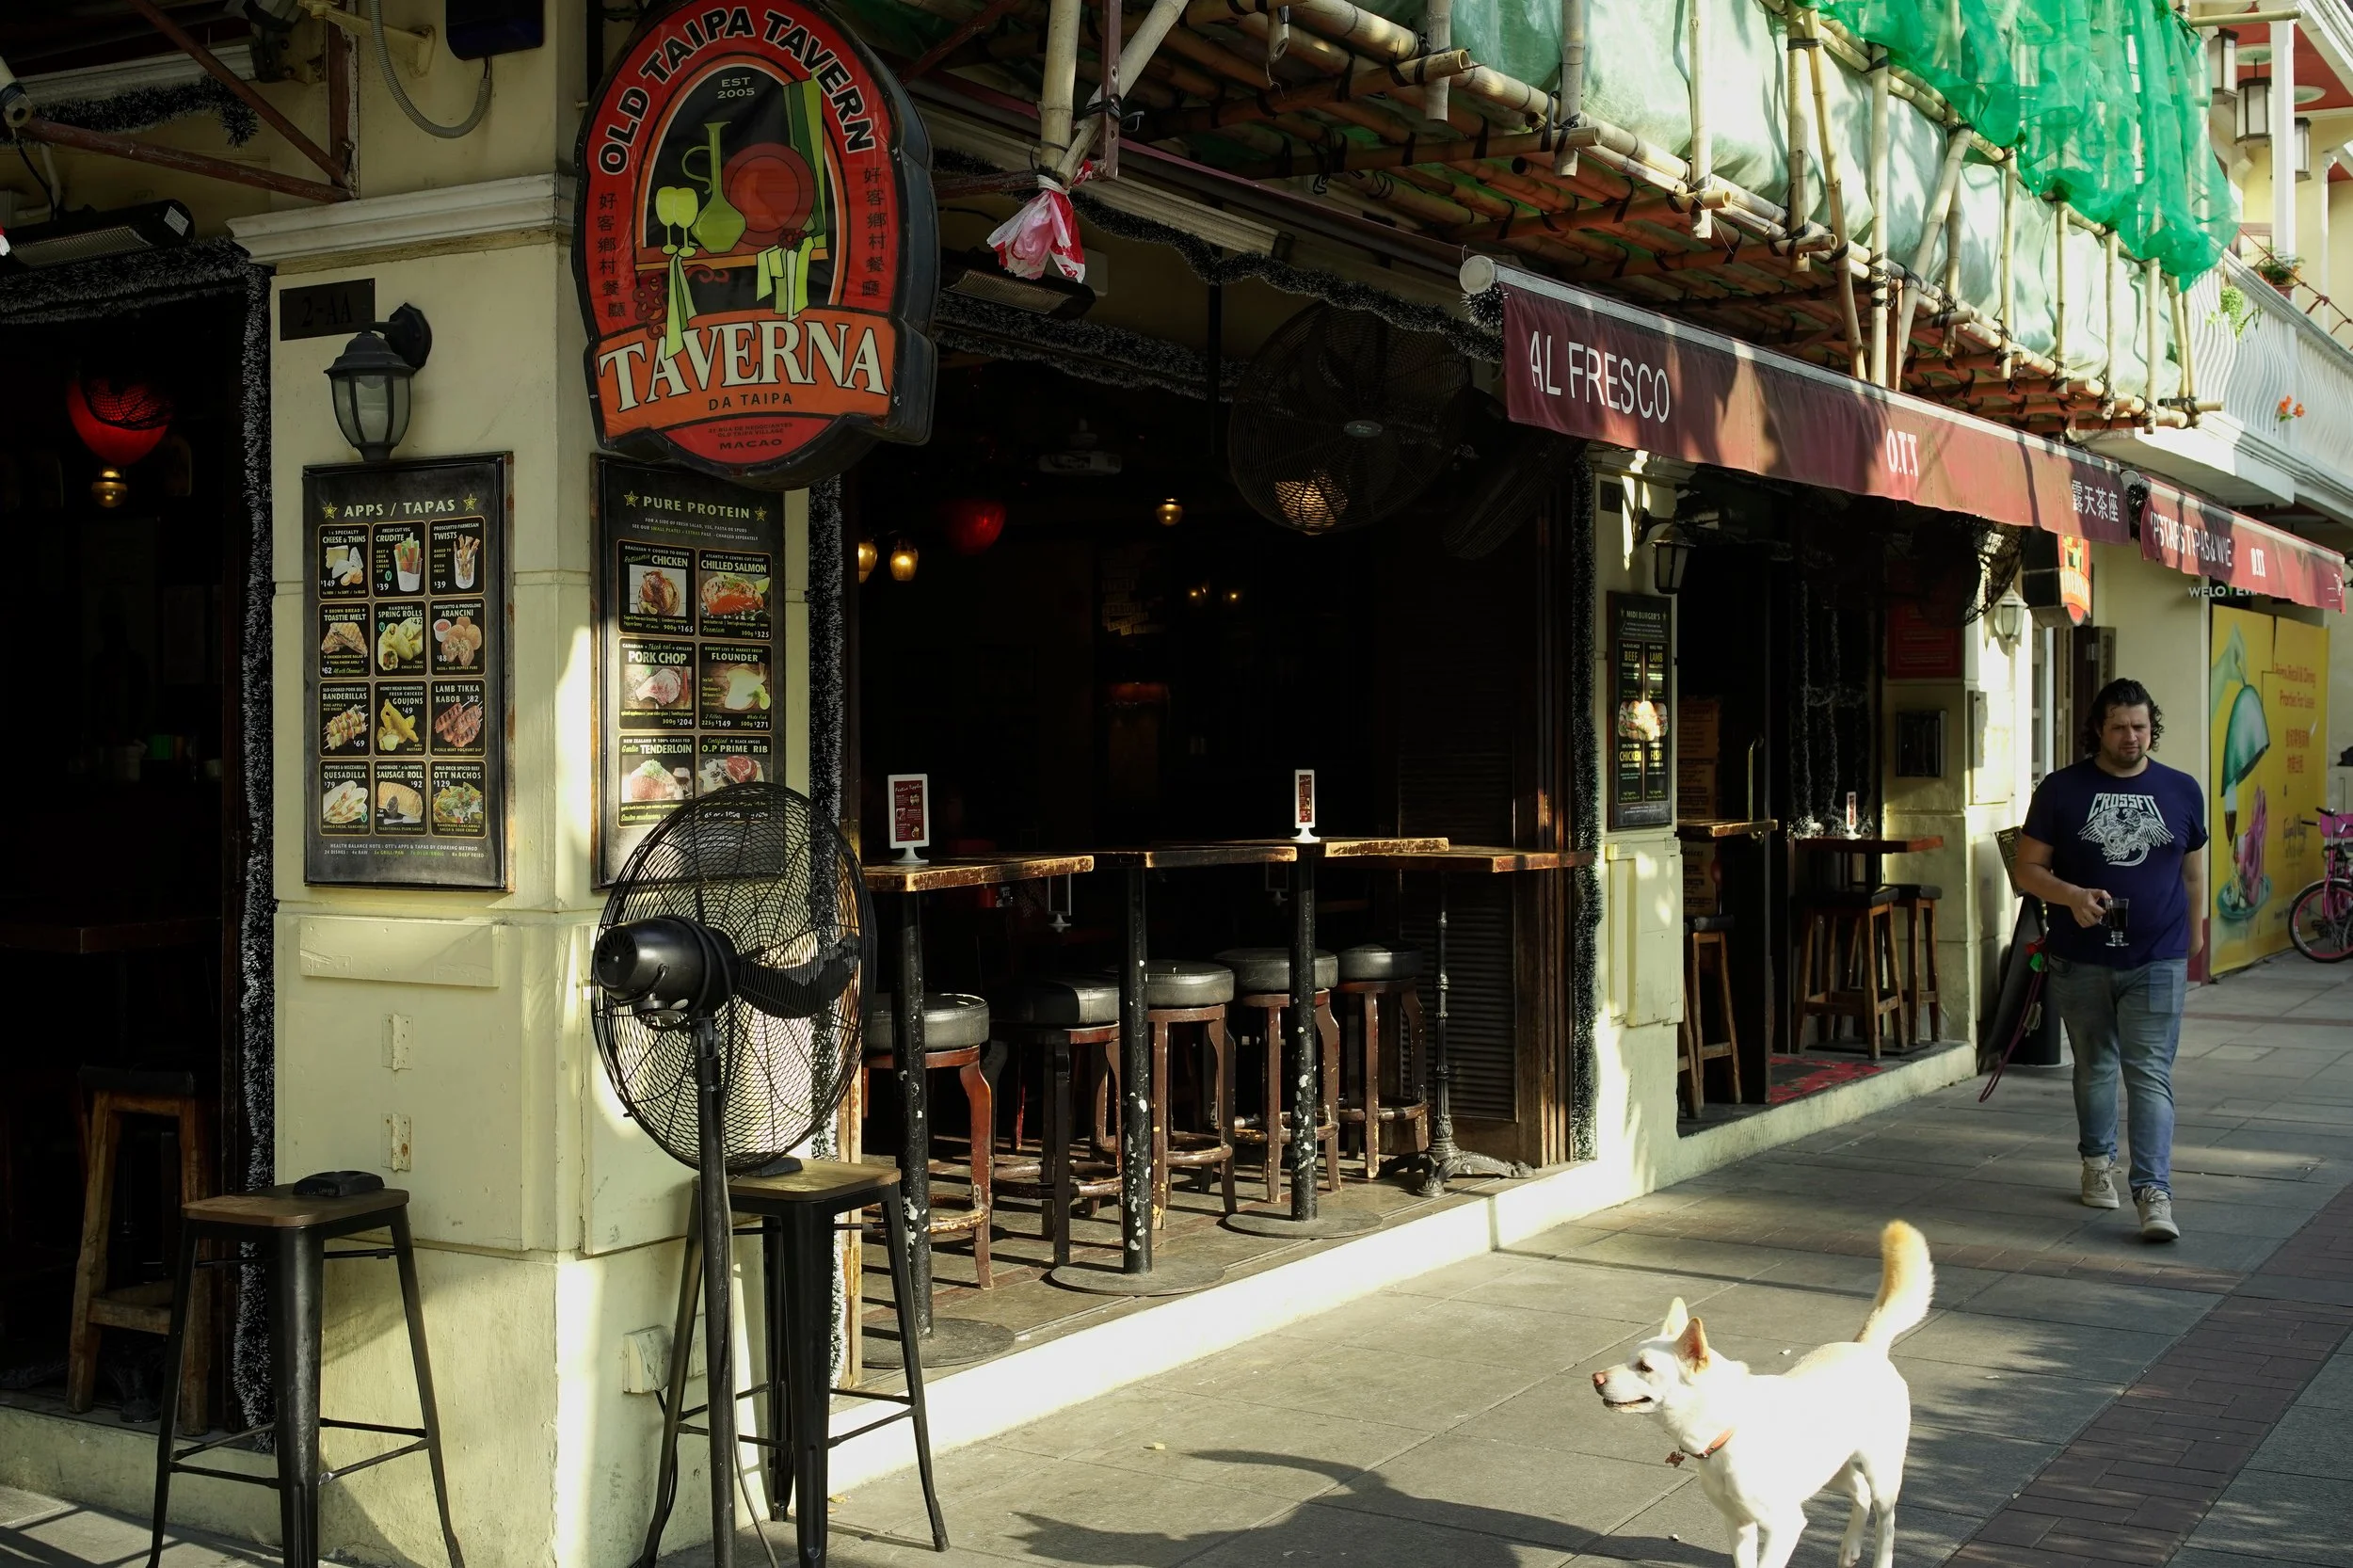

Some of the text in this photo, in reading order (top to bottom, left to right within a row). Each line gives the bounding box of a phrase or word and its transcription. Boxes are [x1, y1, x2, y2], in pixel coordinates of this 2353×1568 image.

[721, 76, 751, 88] EST
[599, 7, 875, 175] OLD TAIPA TAVERN
[717, 88, 755, 99] 2005
[599, 320, 888, 413] TAVERNA
[1530, 330, 1670, 424] AL FRESCO
[709, 392, 793, 411] DA TAIPA
[720, 439, 782, 450] MACAO
[1886, 428, 1919, 476] O.T.T
[2072, 479, 2119, 522] 露天茶座
[344, 504, 384, 518] APPS
[404, 499, 456, 515] TAPAS
[643, 495, 750, 519] PURE PROTEIN
[433, 532, 457, 540] TWISTS
[651, 555, 688, 567] CHICKEN
[701, 559, 767, 573] CHILLED SALMON
[320, 580, 335, 588] $149
[376, 583, 389, 591] $39
[433, 581, 447, 589] $39
[403, 609, 423, 617] ROLLS
[440, 609, 474, 617] ARANCINI
[677, 625, 694, 633] $165
[754, 630, 770, 638] $325
[628, 650, 687, 664] PORK CHOP
[711, 652, 759, 662] FLOUNDER
[456, 684, 480, 693] TIKKA
[392, 697, 424, 706] GOUJONS
[435, 695, 460, 703] KABOB
[467, 695, 480, 703] $82
[402, 706, 413, 714] $49
[677, 717, 693, 726] $204
[702, 719, 731, 728] 225g $149
[754, 720, 770, 728] $271
[640, 744, 693, 754] TENDERLOIN
[701, 744, 769, 754] O.P PRIME RIB
[1619, 749, 1641, 761] CHICKEN
[324, 771, 366, 779] QUESADILLA
[376, 771, 424, 779] SAUSAGE ROLL
[450, 772, 482, 780] NACHOS
